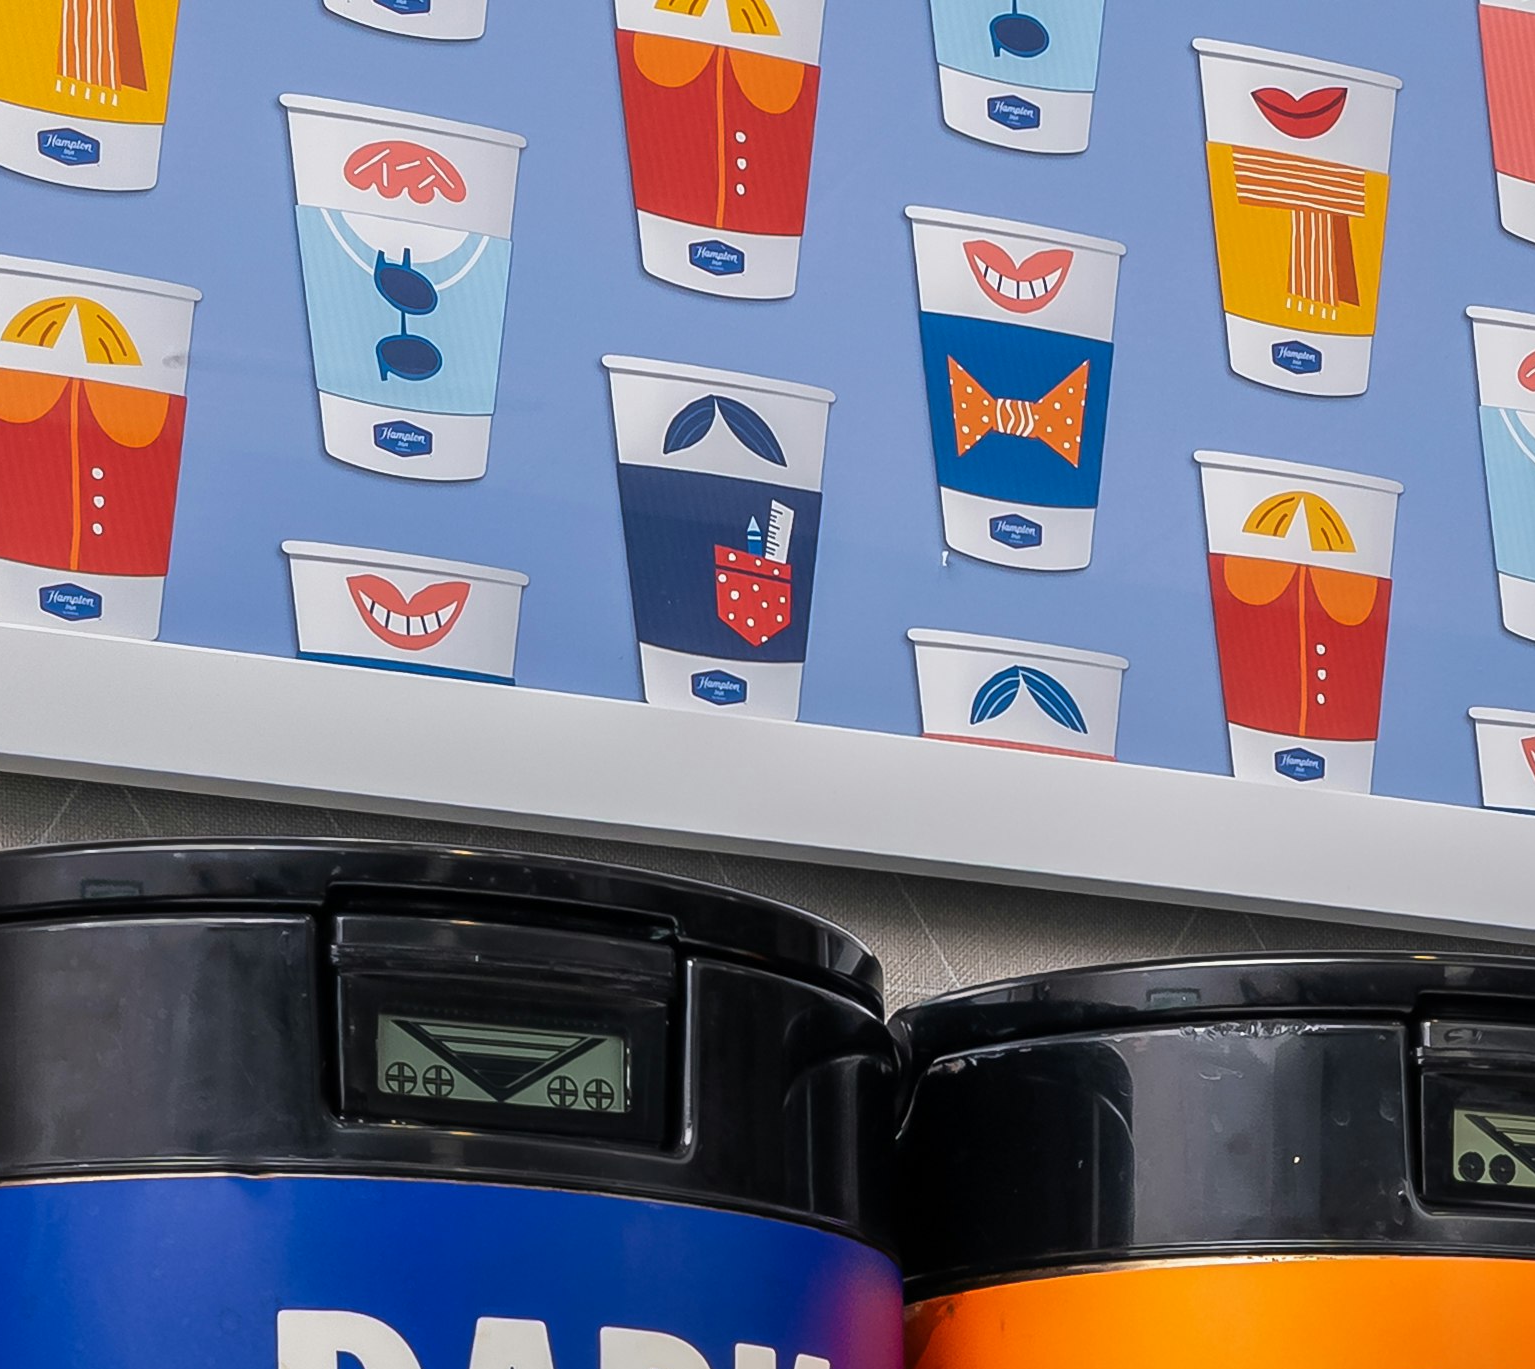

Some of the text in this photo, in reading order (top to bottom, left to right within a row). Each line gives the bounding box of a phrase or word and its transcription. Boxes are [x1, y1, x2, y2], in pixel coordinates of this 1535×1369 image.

[992, 100, 1034, 118] Hampton
[44, 133, 94, 152] Hampton
[696, 246, 738, 263] Hampton
[1276, 346, 1316, 362] Hampton
[380, 426, 426, 443] Hampton
[996, 520, 1036, 537] Hampton
[46, 590, 94, 607] Hampton
[696, 676, 740, 693] Hampton
[1280, 753, 1320, 770] Hampton
